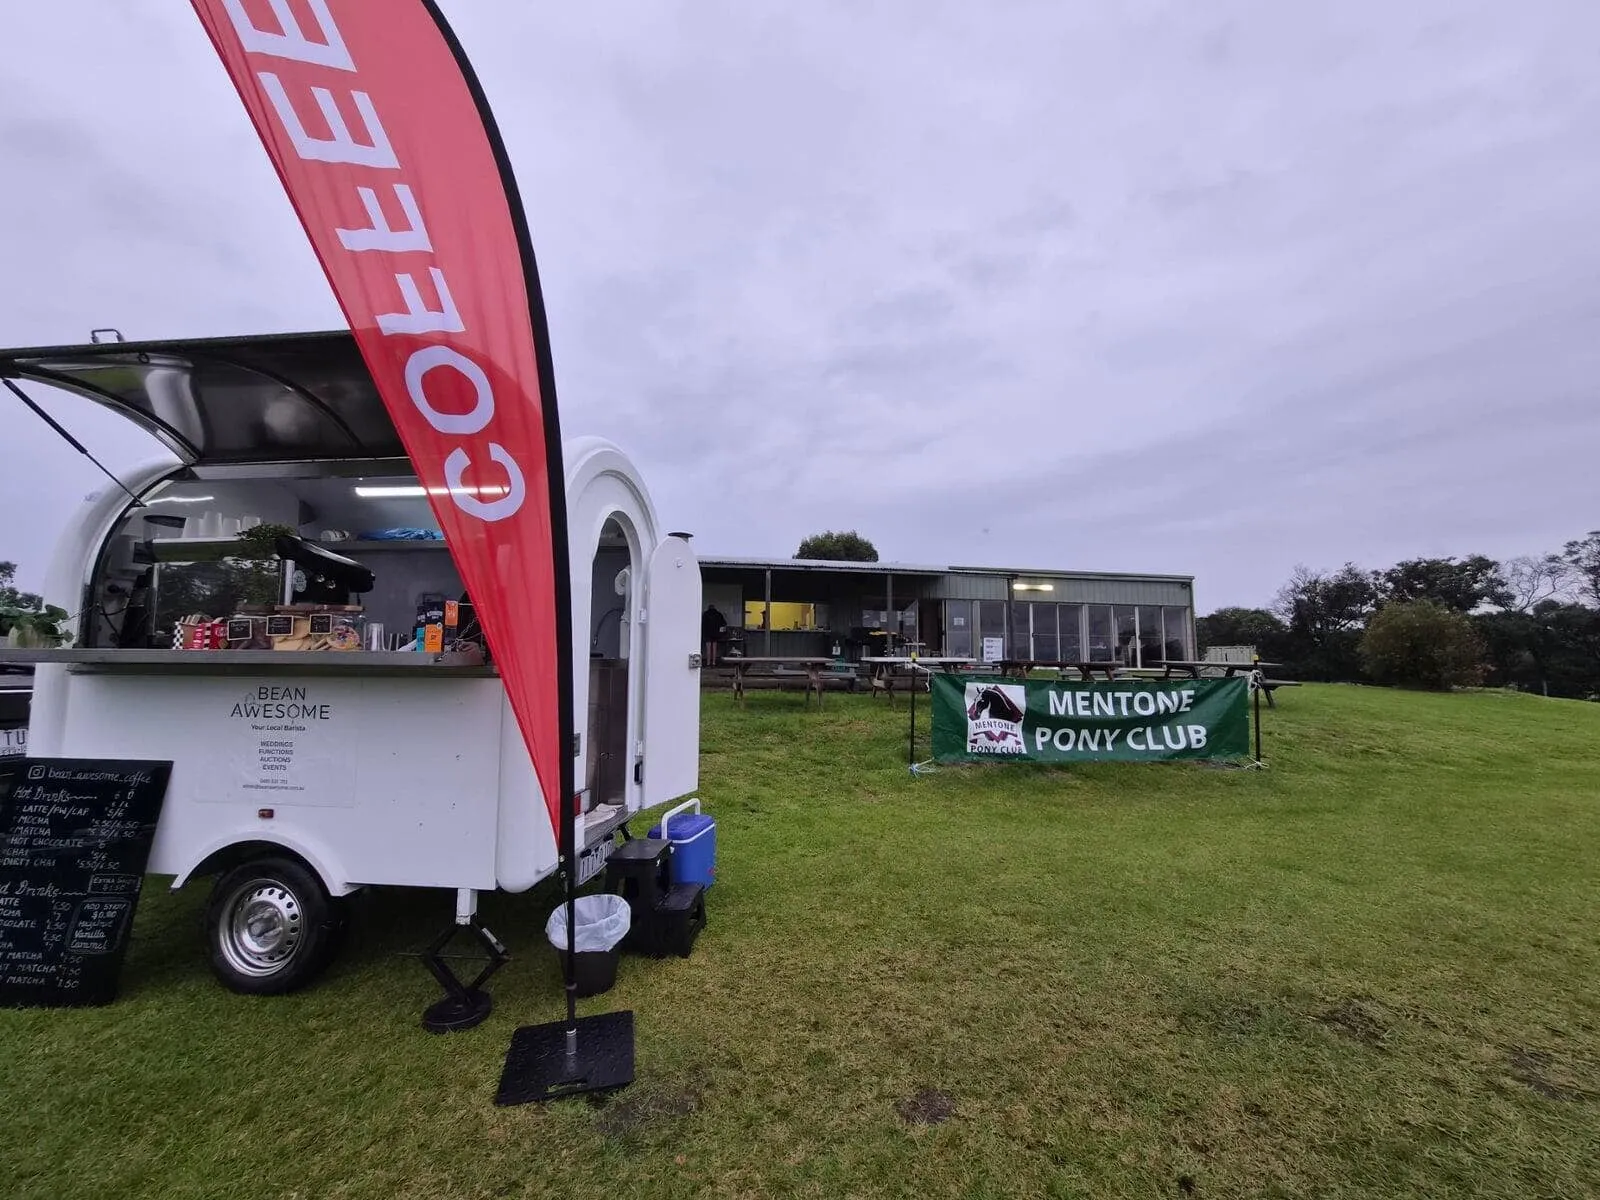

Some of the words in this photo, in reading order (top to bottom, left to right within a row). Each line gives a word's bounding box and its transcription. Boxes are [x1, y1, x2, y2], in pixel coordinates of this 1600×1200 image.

[221, 0, 526, 522] COFFEE
[258, 686, 306, 700] BEAN
[1048, 689, 1195, 716] MENTONE
[230, 703, 331, 720] AWESOME
[974, 720, 1015, 732] MENTONE
[260, 740, 294, 748] WEDDINGS
[1035, 726, 1122, 752] PONY
[1126, 724, 1208, 751] CLUB
[970, 745, 997, 753] PONY
[1000, 745, 1023, 753] CLUB
[13, 785, 33, 799] Hot
[17, 815, 49, 825] MOCHA
[13, 826, 51, 837] MATCHA
[10, 836, 30, 845] HOT
[15, 879, 60, 897] Drinks
